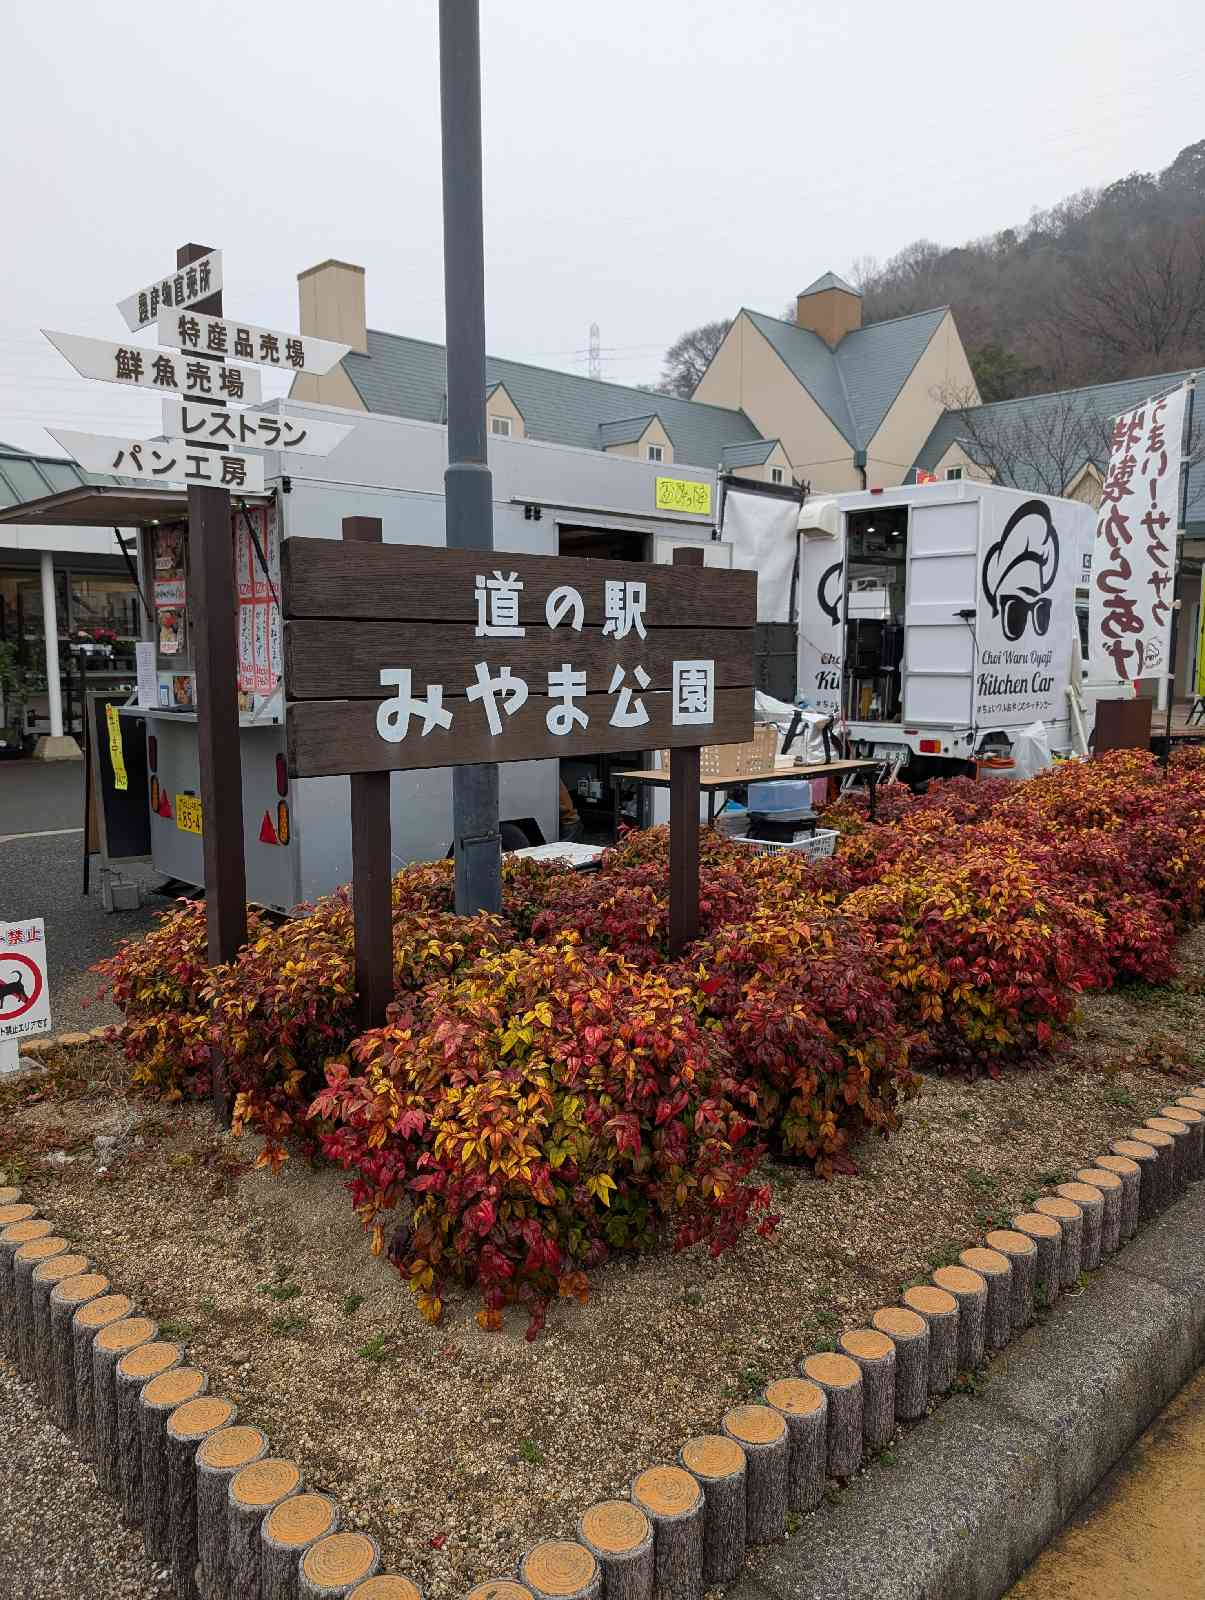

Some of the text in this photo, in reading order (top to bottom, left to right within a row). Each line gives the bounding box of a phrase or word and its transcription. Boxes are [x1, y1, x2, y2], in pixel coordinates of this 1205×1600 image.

[178, 314, 305, 368] 特産品売場
[114, 347, 245, 399] 鮮魚売場
[181, 406, 307, 446] レストラン
[112, 444, 247, 486] パン工房
[474, 570, 648, 641] 道の駅
[375, 659, 715, 743] みやま公園
[977, 671, 1055, 696] Kitchen Car
